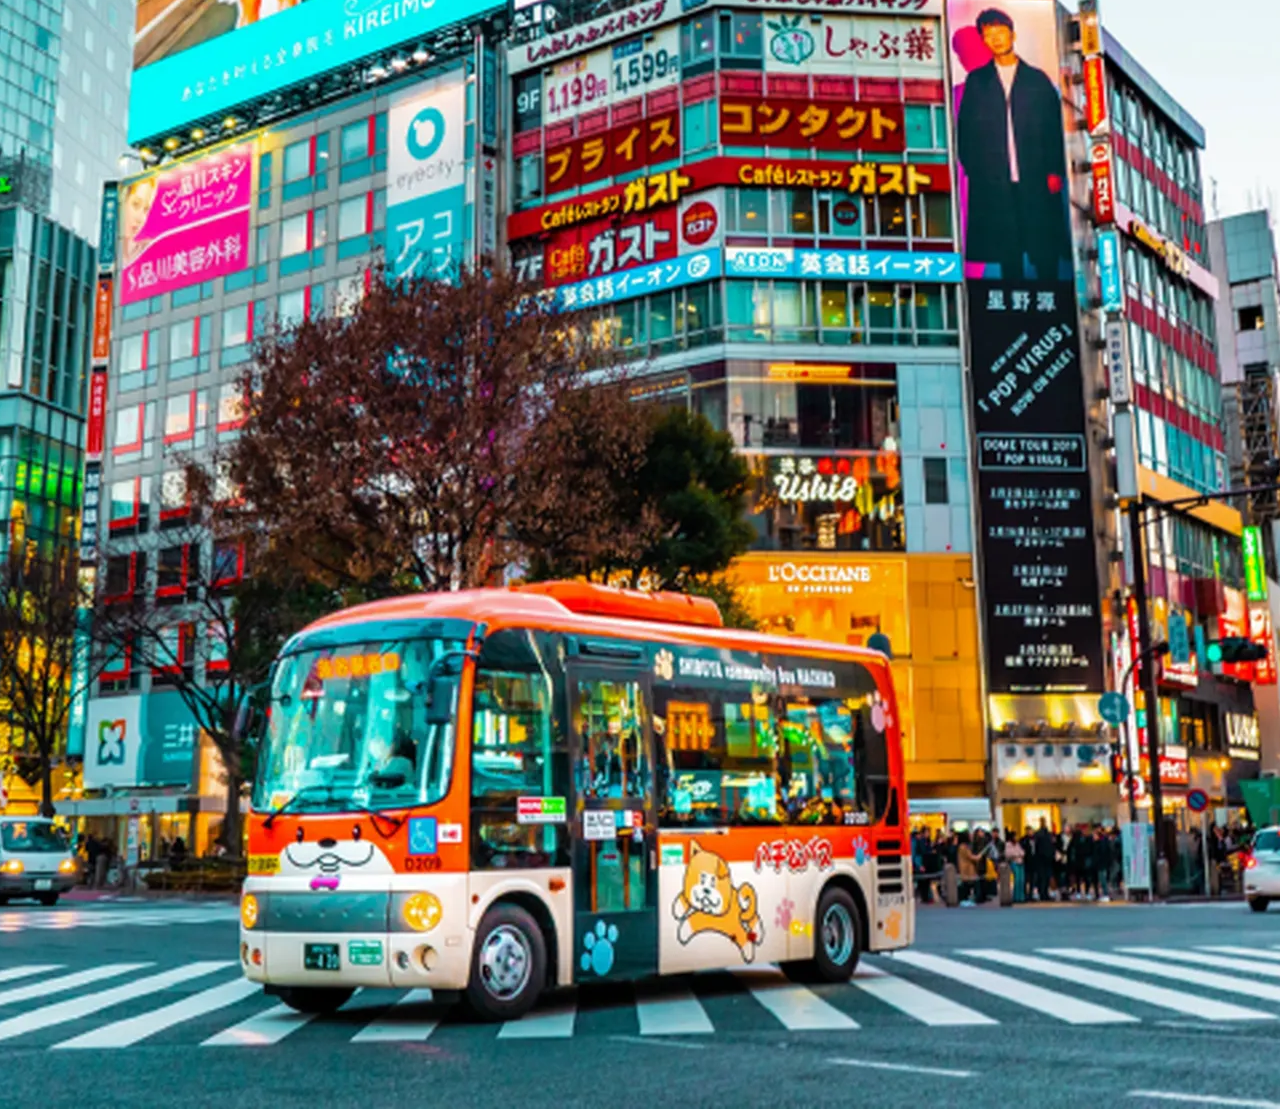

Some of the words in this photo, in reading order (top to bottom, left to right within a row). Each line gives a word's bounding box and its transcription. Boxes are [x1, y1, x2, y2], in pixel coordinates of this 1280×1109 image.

[824, 25, 936, 61] しゃぶ葉
[516, 89, 541, 114] 9F
[722, 102, 898, 141] コンタクト
[547, 117, 677, 184] プライス
[623, 169, 691, 214] ガスト
[848, 161, 932, 196] ガスト
[588, 221, 670, 276] ガスト
[799, 252, 957, 277] 英会話イーオン
[514, 255, 545, 283] 7F
